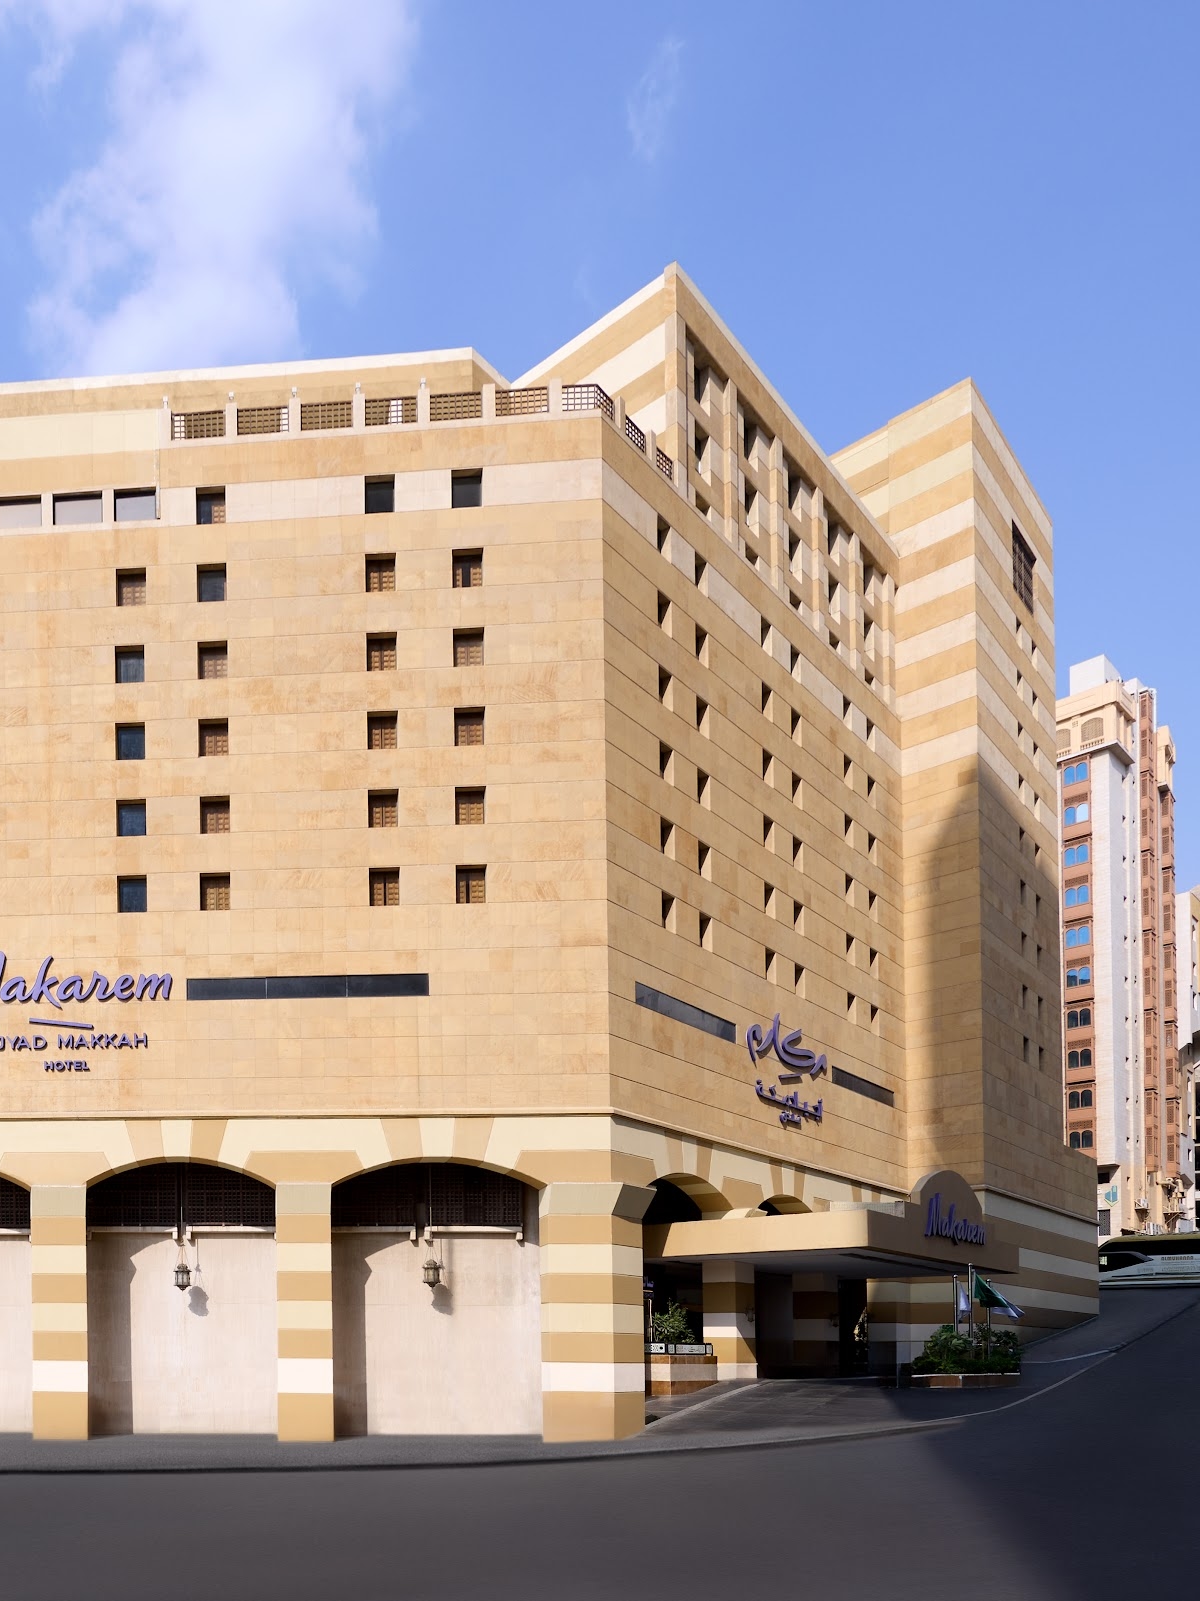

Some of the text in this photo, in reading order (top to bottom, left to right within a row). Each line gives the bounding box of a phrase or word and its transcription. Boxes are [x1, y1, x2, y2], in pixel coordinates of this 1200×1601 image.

[57, 1033, 148, 1050] MAKKAH
[746, 1013, 827, 1075] مكارم
[43, 1060, 90, 1072] HOTEL
[924, 1193, 986, 1246] Makarem
